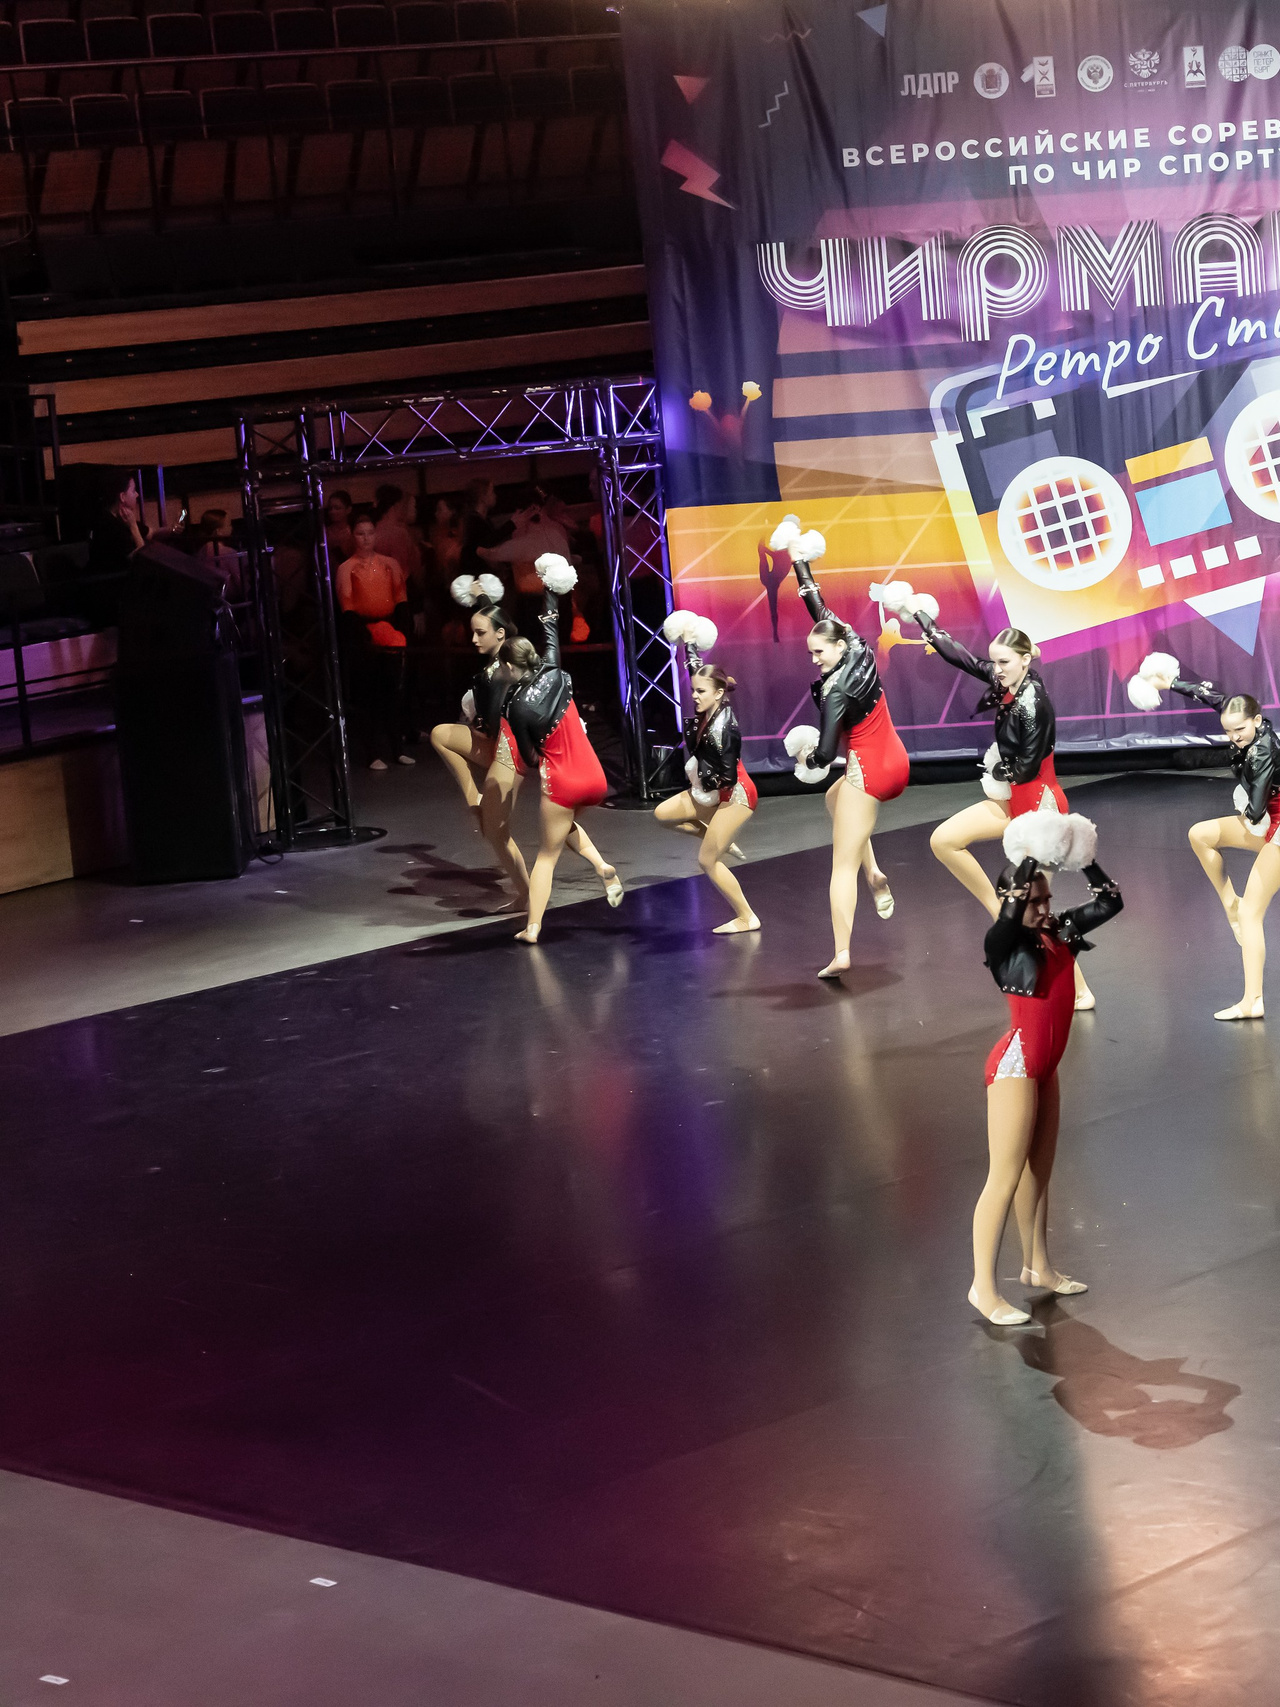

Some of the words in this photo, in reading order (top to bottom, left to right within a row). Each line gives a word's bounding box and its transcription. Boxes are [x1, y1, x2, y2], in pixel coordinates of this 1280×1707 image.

[901, 71, 959, 98] ЛДПР
[842, 127, 1151, 168] ВСЕРОССИЙСКИЕ
[1008, 163, 1055, 186] ПО
[1072, 157, 1142, 180] ЧИР
[996, 333, 1163, 400] Ретро
